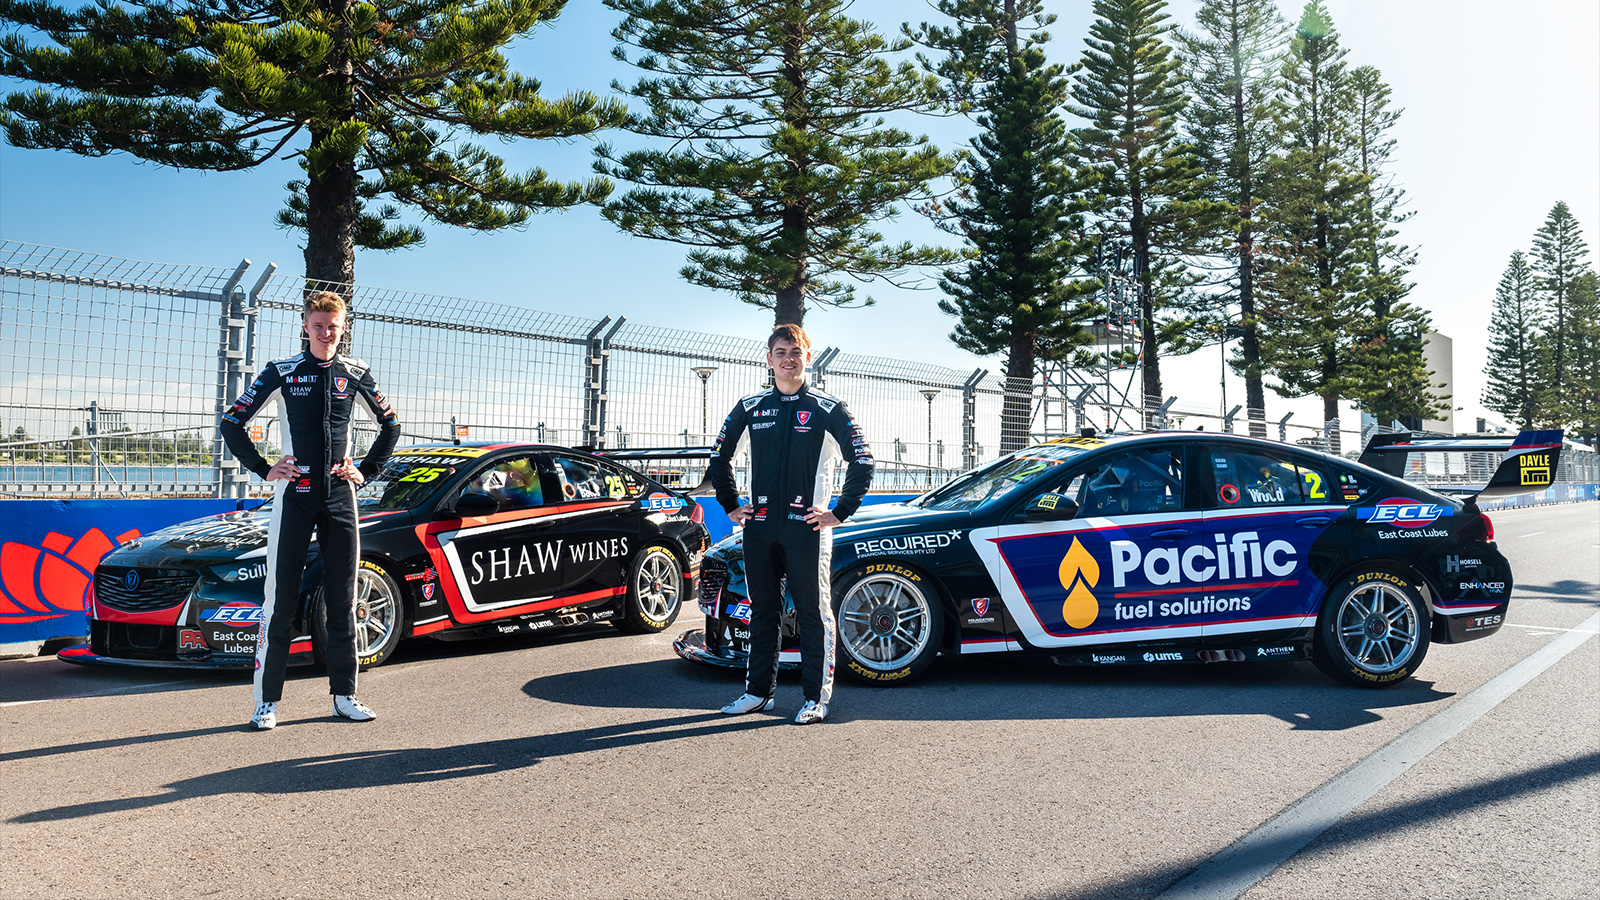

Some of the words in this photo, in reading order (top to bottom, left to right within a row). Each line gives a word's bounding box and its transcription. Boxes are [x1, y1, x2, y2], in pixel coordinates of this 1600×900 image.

[286, 375, 307, 383] Mobil
[753, 409, 770, 417] Mobil
[1520, 455, 1550, 467] DAYLE
[398, 467, 447, 483] 25
[1011, 464, 1047, 480] 2
[605, 475, 626, 498] 25
[1305, 472, 1325, 499] 2
[651, 497, 682, 510] ECL
[1372, 504, 1441, 521] ECL
[1378, 530, 1398, 539] East
[1398, 529, 1423, 538] Coast
[1423, 528, 1449, 537] Lubes
[471, 539, 563, 585] SHAW
[569, 537, 628, 564] WINES
[857, 551, 887, 559] FINANCIAL
[1110, 531, 1298, 588] Pacific
[866, 563, 921, 582] DUNLOP
[1357, 572, 1407, 587] DUNLOP
[1460, 581, 1504, 589] ENHANCED
[1114, 600, 1153, 620] fuel
[1160, 596, 1251, 617] solutions
[1475, 615, 1501, 626] TES
[213, 631, 235, 641] East
[224, 643, 254, 653] Lubes
[1155, 652, 1183, 661] ums
[848, 661, 878, 679] MAXX
[877, 667, 911, 681] SPORT
[1351, 666, 1378, 682] MAXX
[1378, 667, 1408, 682] SPORT
